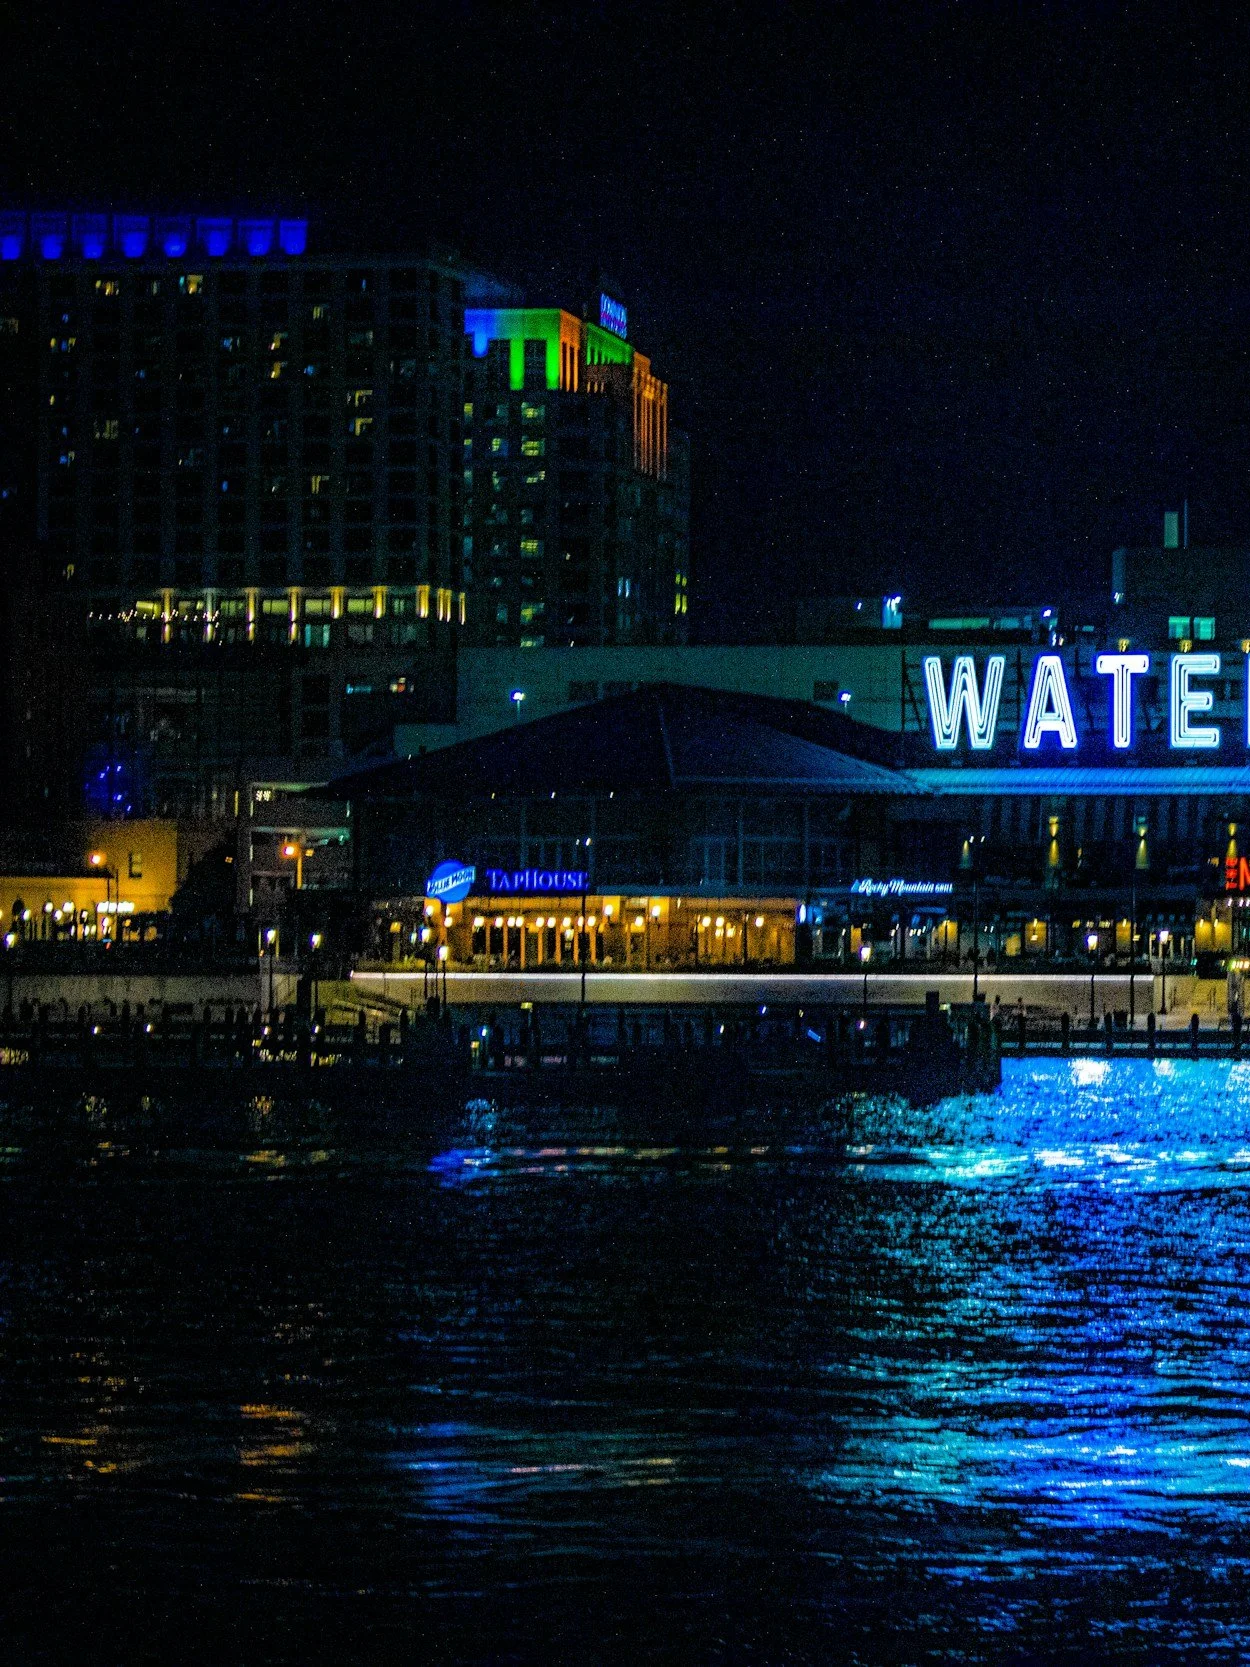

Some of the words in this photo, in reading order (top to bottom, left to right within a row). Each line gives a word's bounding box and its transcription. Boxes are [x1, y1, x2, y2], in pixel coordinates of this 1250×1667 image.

[451, 868, 474, 885] MOON
[1225, 857, 1238, 890] THE
[859, 878, 889, 897] Rocky
[889, 878, 934, 896] Mountain
